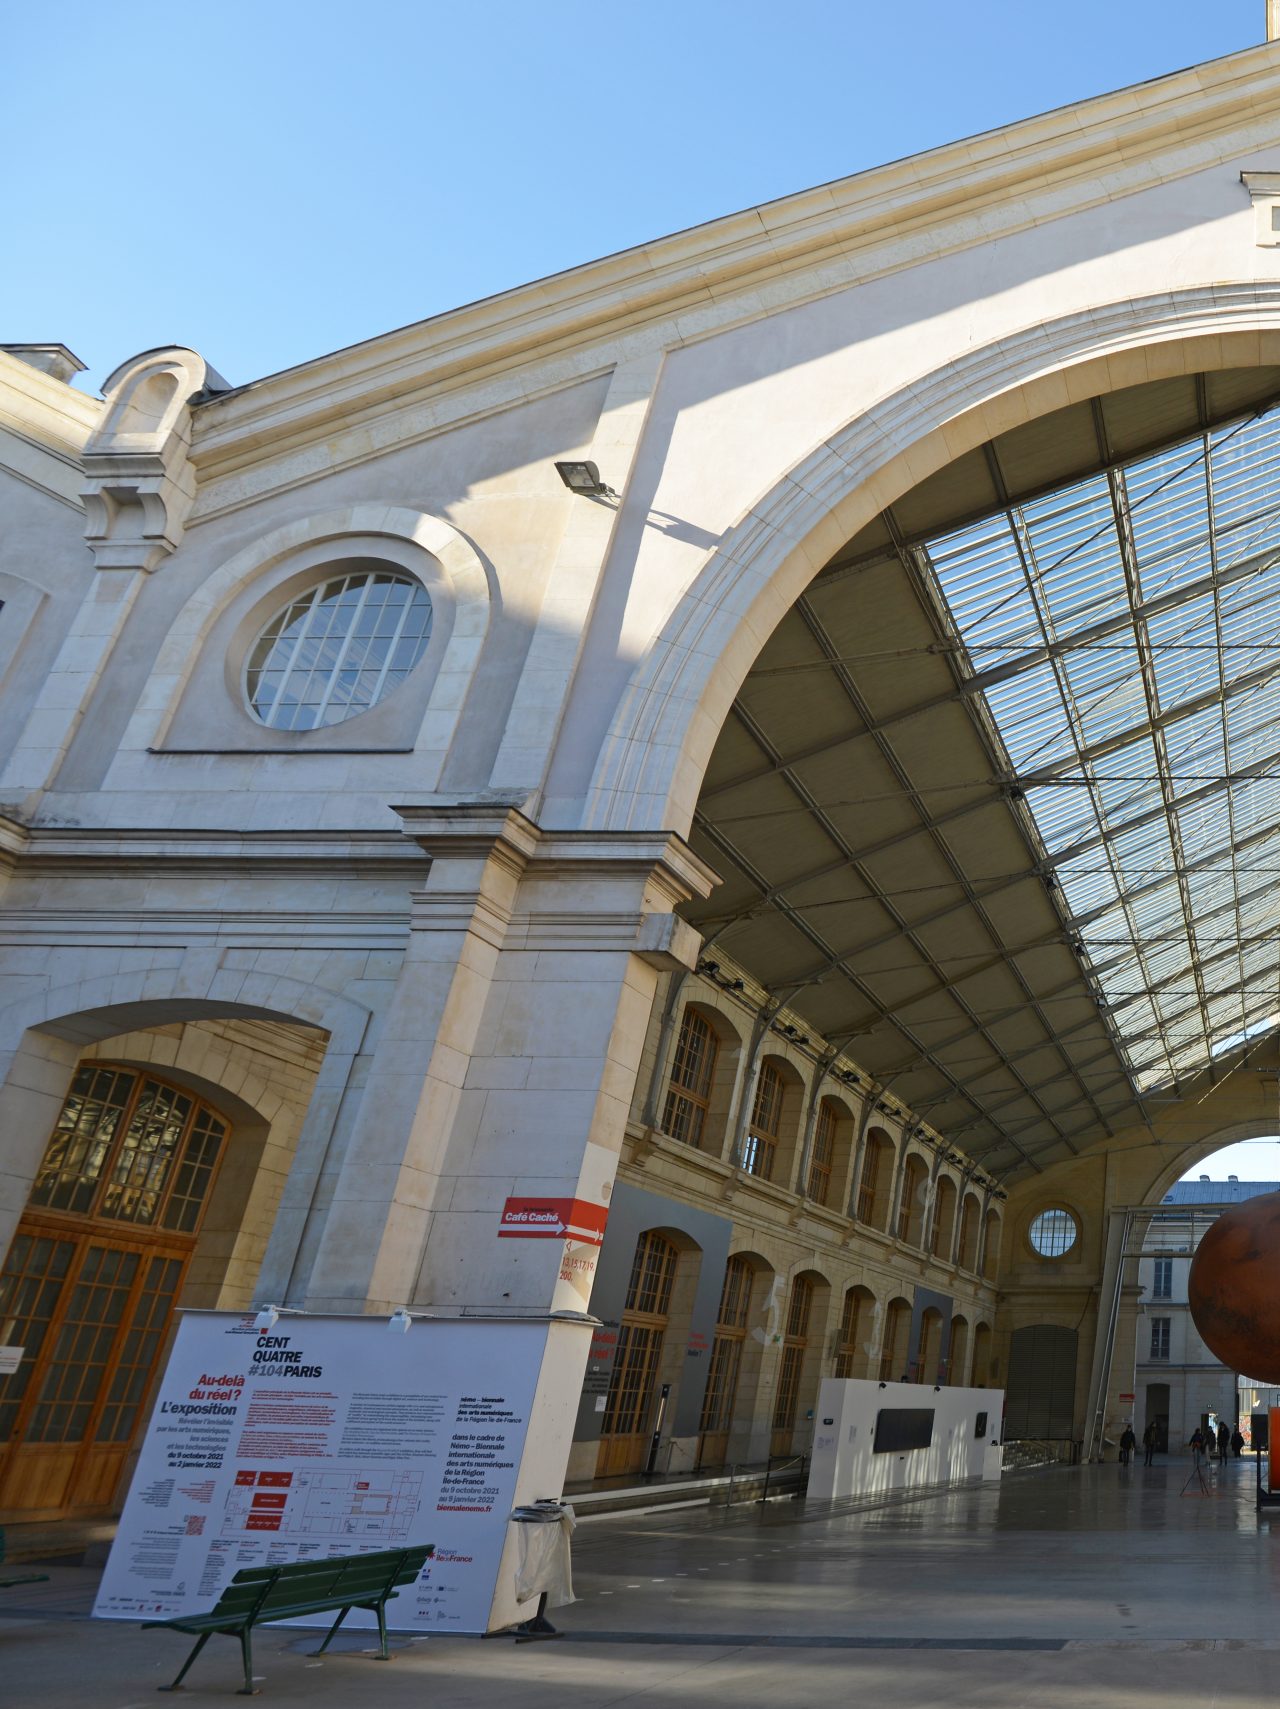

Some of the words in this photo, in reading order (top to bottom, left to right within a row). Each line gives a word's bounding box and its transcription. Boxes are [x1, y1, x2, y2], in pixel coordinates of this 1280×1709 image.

[505, 1212, 528, 1222] Café
[528, 1212, 559, 1222] Caché
[257, 1337, 291, 1348] CENT
[253, 1350, 303, 1363] QUATRE
[197, 1374, 245, 1386] Au-delà
[189, 1388, 205, 1400] du
[207, 1388, 232, 1400] réel
[161, 1401, 237, 1416] L'exposition
[182, 1461, 205, 1469] janvier
[474, 1461, 514, 1469] numériques
[461, 1469, 485, 1477] Région
[436, 1504, 492, 1512] biennalenemo.fr
